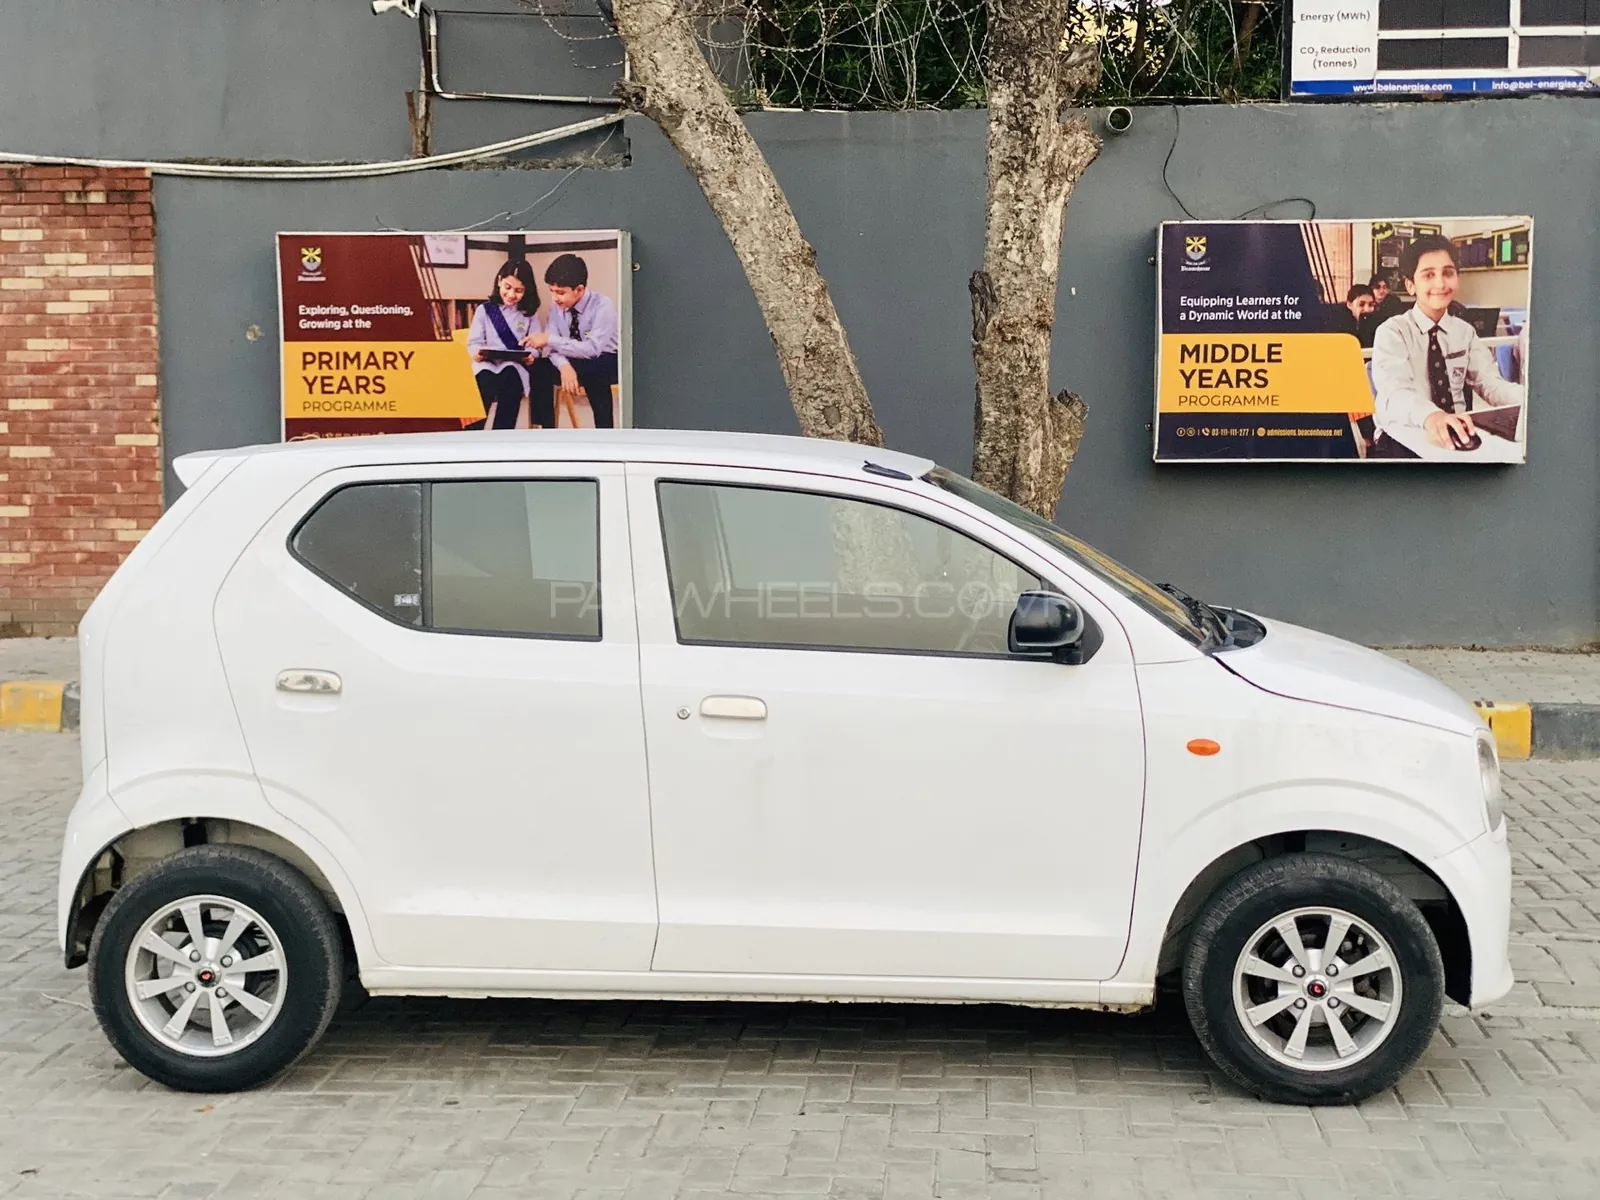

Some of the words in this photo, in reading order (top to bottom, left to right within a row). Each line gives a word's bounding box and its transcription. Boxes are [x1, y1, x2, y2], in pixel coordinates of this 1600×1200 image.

[1300, 13, 1335, 23] Energy
[1336, 10, 1371, 22] (MWh)
[1320, 46, 1371, 54] Reduction
[1312, 58, 1357, 70] (Tonnes)
[1180, 295, 1234, 307] Equipping
[1236, 295, 1282, 306] Learners
[1283, 294, 1300, 305] for
[298, 304, 350, 317] Exploring,
[350, 304, 414, 317] Questioning,
[1179, 312, 1187, 321] a
[1188, 310, 1234, 322] Dynamic
[1236, 309, 1269, 320] World
[1271, 310, 1282, 320] at
[1284, 309, 1302, 320] the
[299, 319, 342, 330] Growing
[342, 320, 353, 329] at
[355, 319, 372, 329] the
[1180, 343, 1283, 363] MIDDLE
[302, 351, 415, 370] PRIMARY
[302, 375, 387, 394] YEARS
[1179, 368, 1269, 389] YEARS
[302, 400, 397, 412] PROGRAMME
[1178, 395, 1280, 407] PROGRAMME
